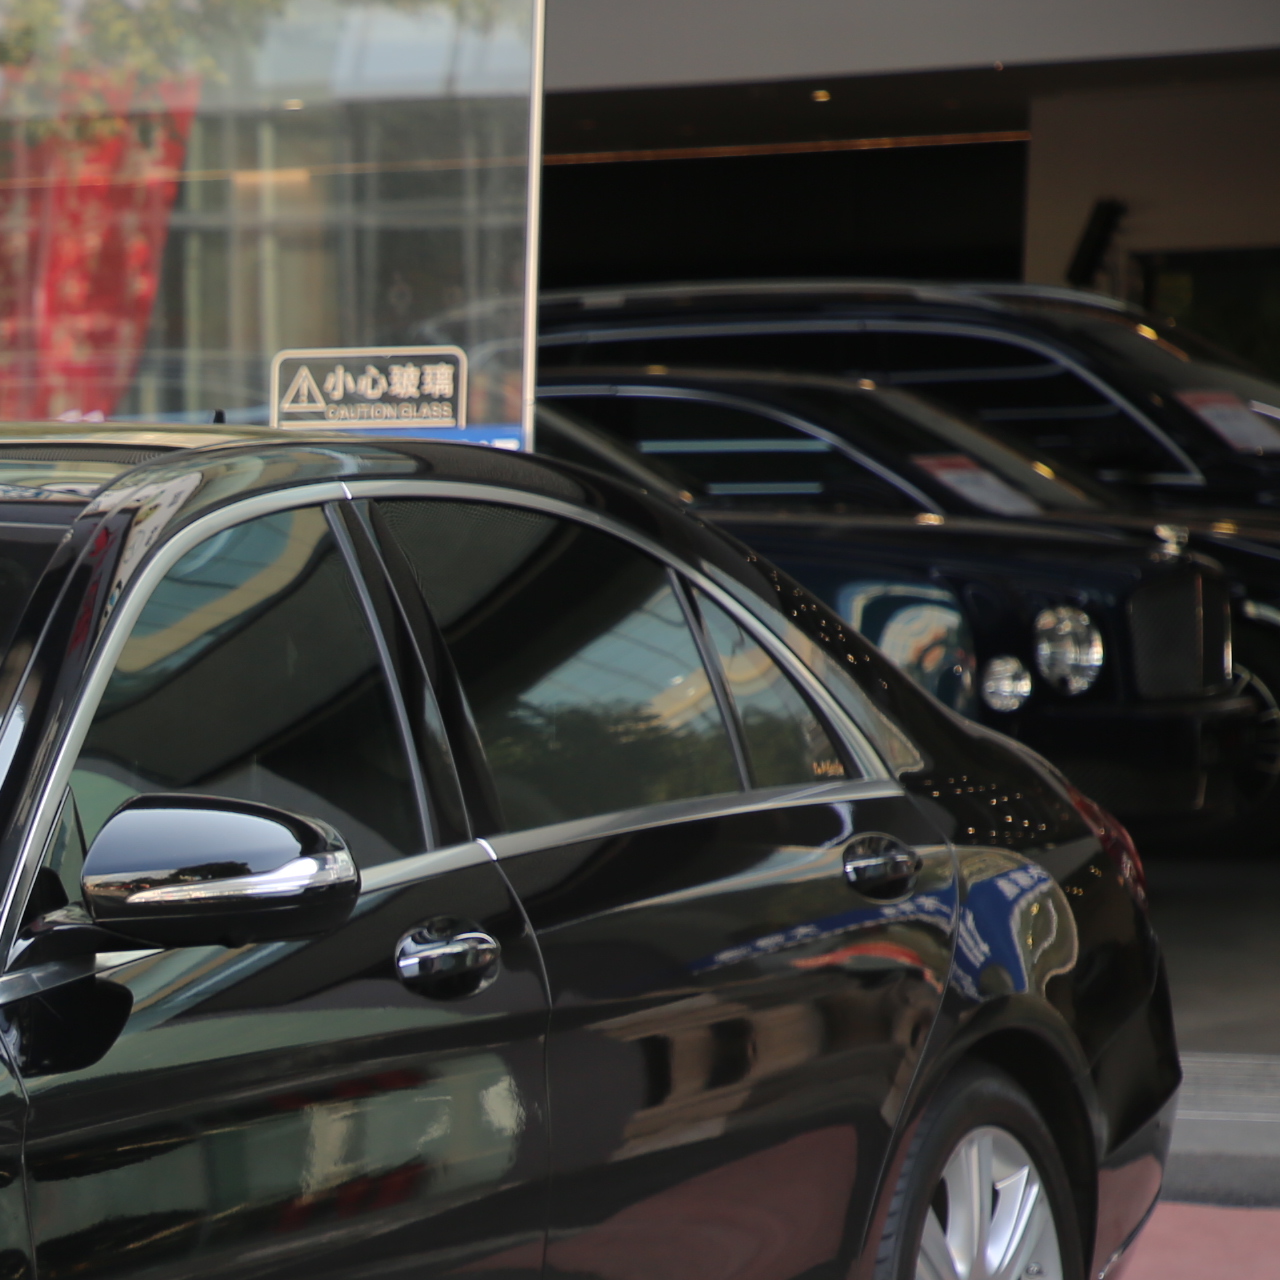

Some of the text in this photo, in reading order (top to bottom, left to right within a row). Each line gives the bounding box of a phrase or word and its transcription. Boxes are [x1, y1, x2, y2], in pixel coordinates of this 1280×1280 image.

[323, 362, 455, 400] 小心玻璃
[324, 402, 453, 421] CAUTION GLASS
